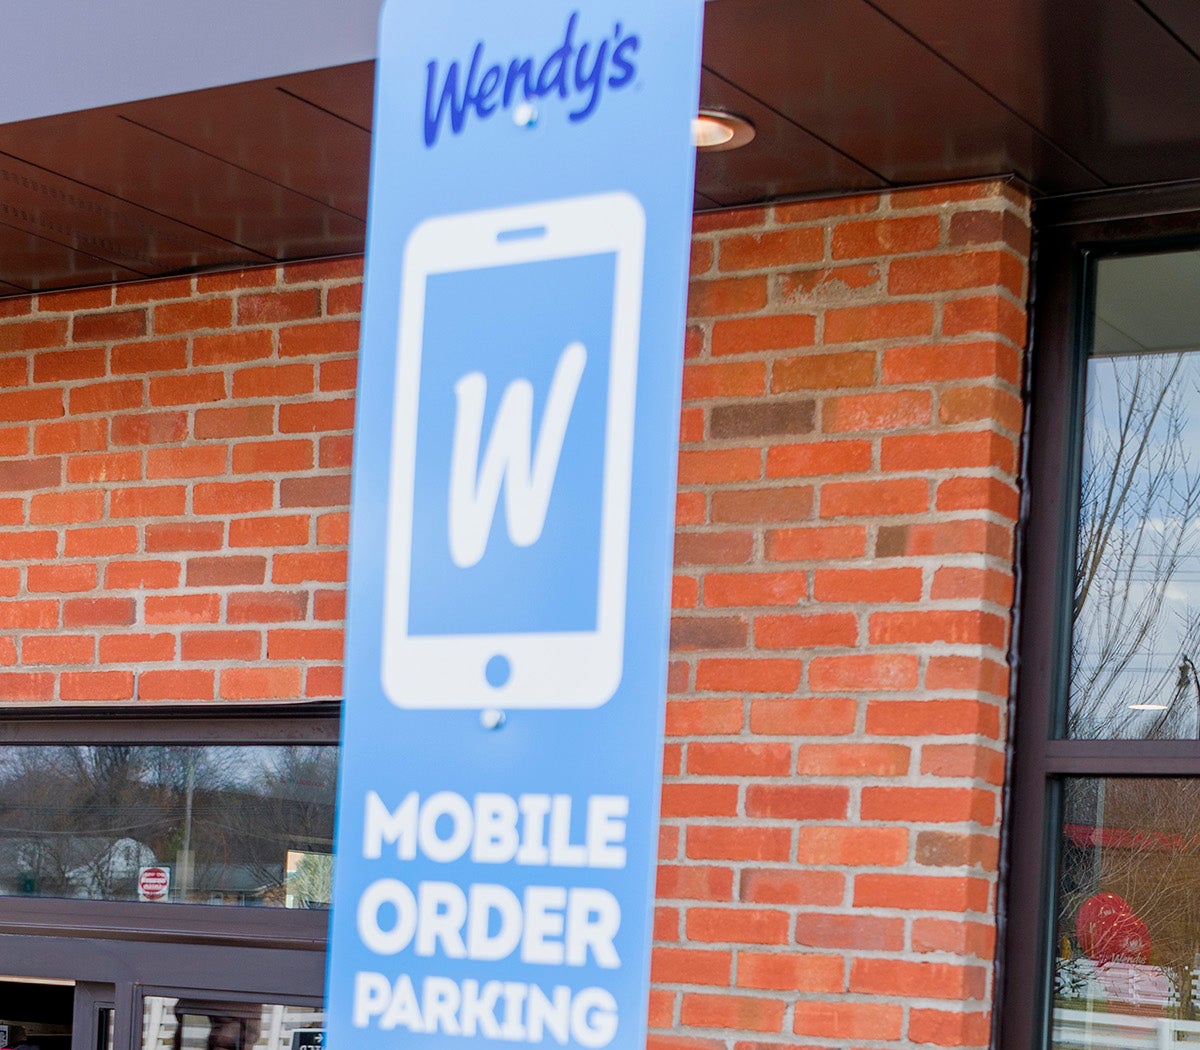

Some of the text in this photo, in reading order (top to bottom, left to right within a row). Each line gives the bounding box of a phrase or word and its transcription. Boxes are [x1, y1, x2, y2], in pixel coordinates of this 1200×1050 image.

[423, 11, 639, 148] Wendy's
[448, 341, 588, 568] W
[363, 790, 629, 869] MOBILE
[357, 878, 621, 969] ORDER
[353, 971, 618, 1049] PARKING
